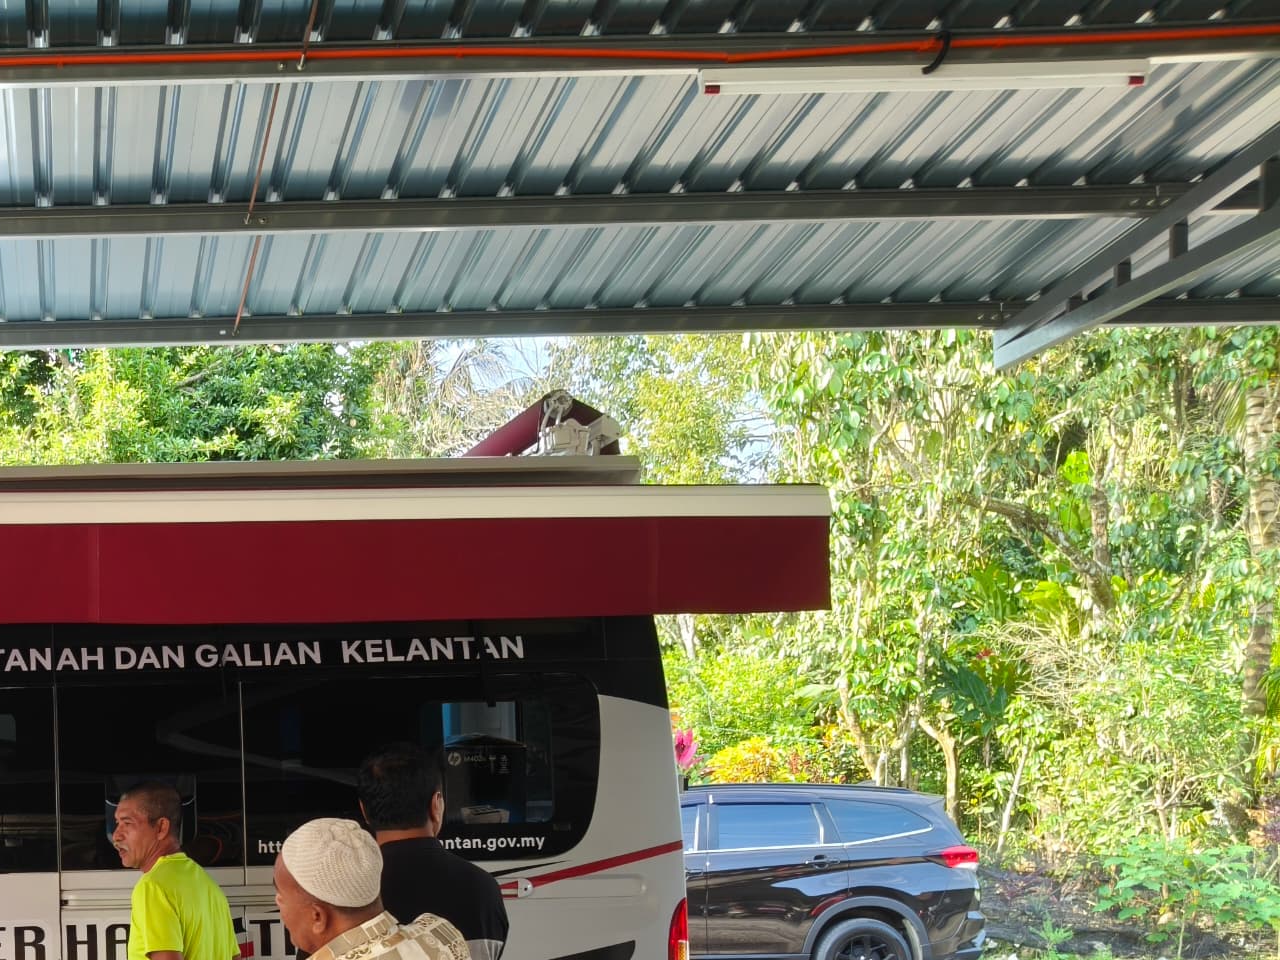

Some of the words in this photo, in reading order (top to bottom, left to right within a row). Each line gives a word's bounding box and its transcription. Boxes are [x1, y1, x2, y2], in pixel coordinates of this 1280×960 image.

[114, 645, 185, 671] DAN
[194, 641, 321, 668] GALIAN
[341, 635, 525, 664] KELANTAN
